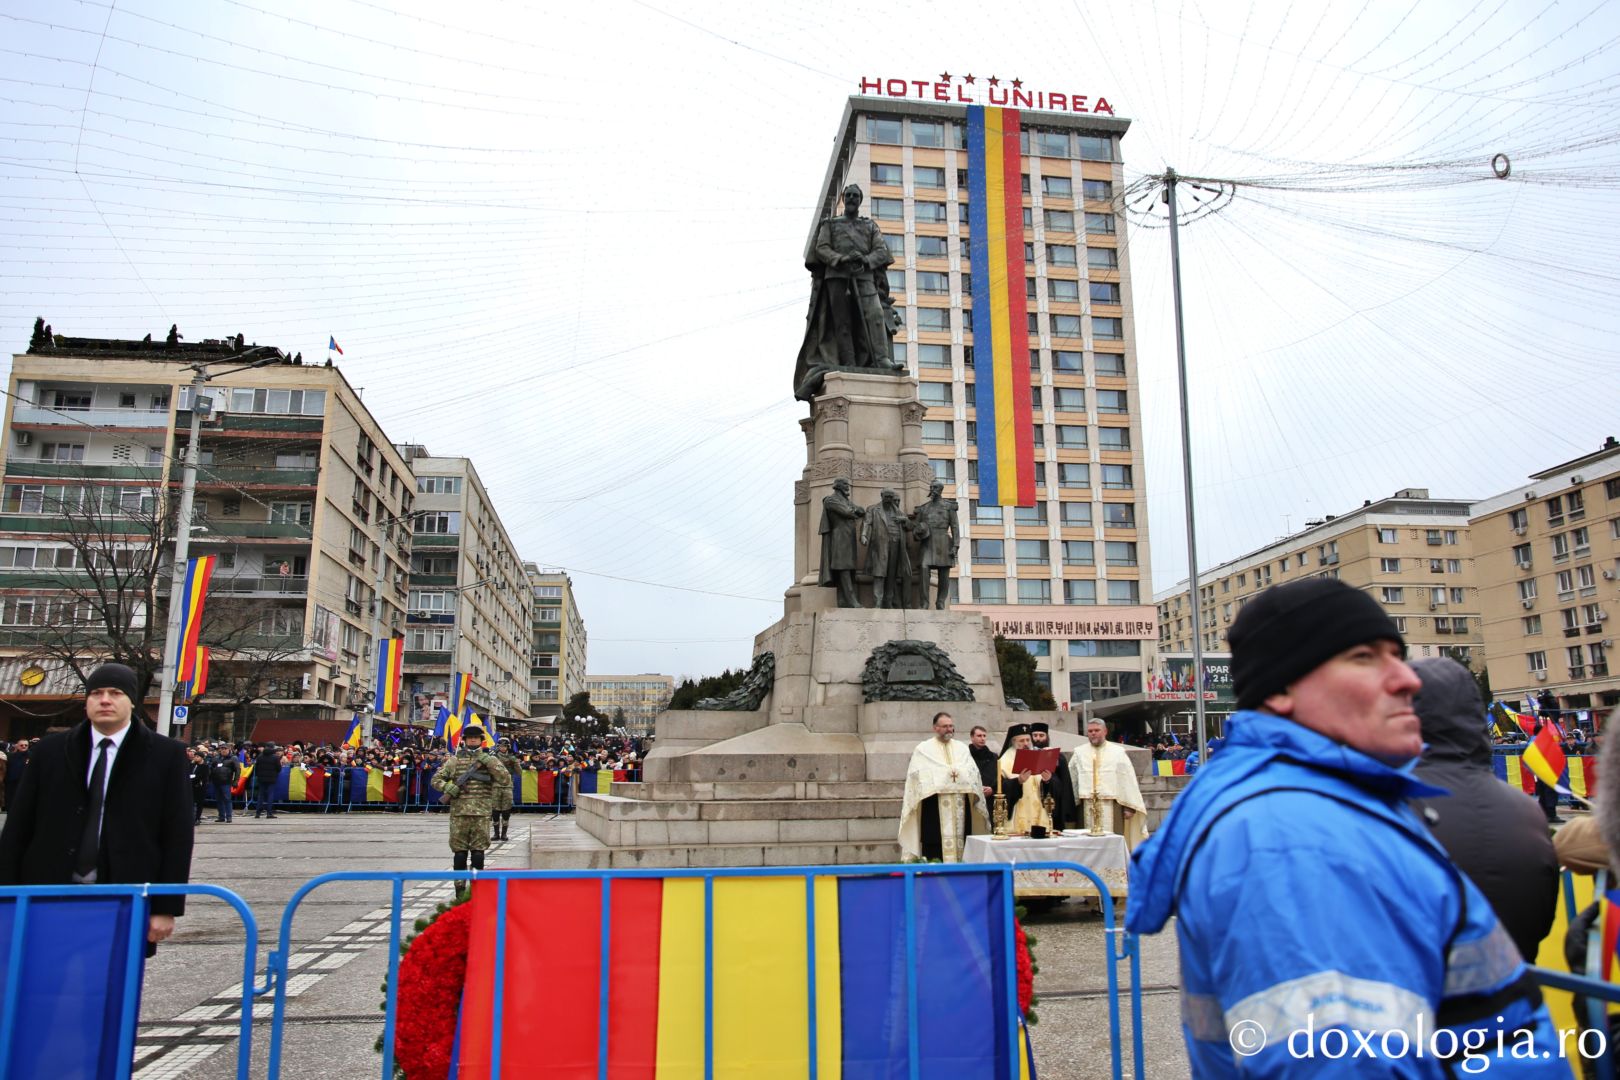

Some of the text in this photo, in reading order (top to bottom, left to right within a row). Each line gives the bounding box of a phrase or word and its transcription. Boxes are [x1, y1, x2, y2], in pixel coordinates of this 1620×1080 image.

[861, 76, 1115, 115] HOTEL UNIREA
[1212, 674, 1219, 682] 2
[1154, 692, 1215, 700] HOTEL UNEA
